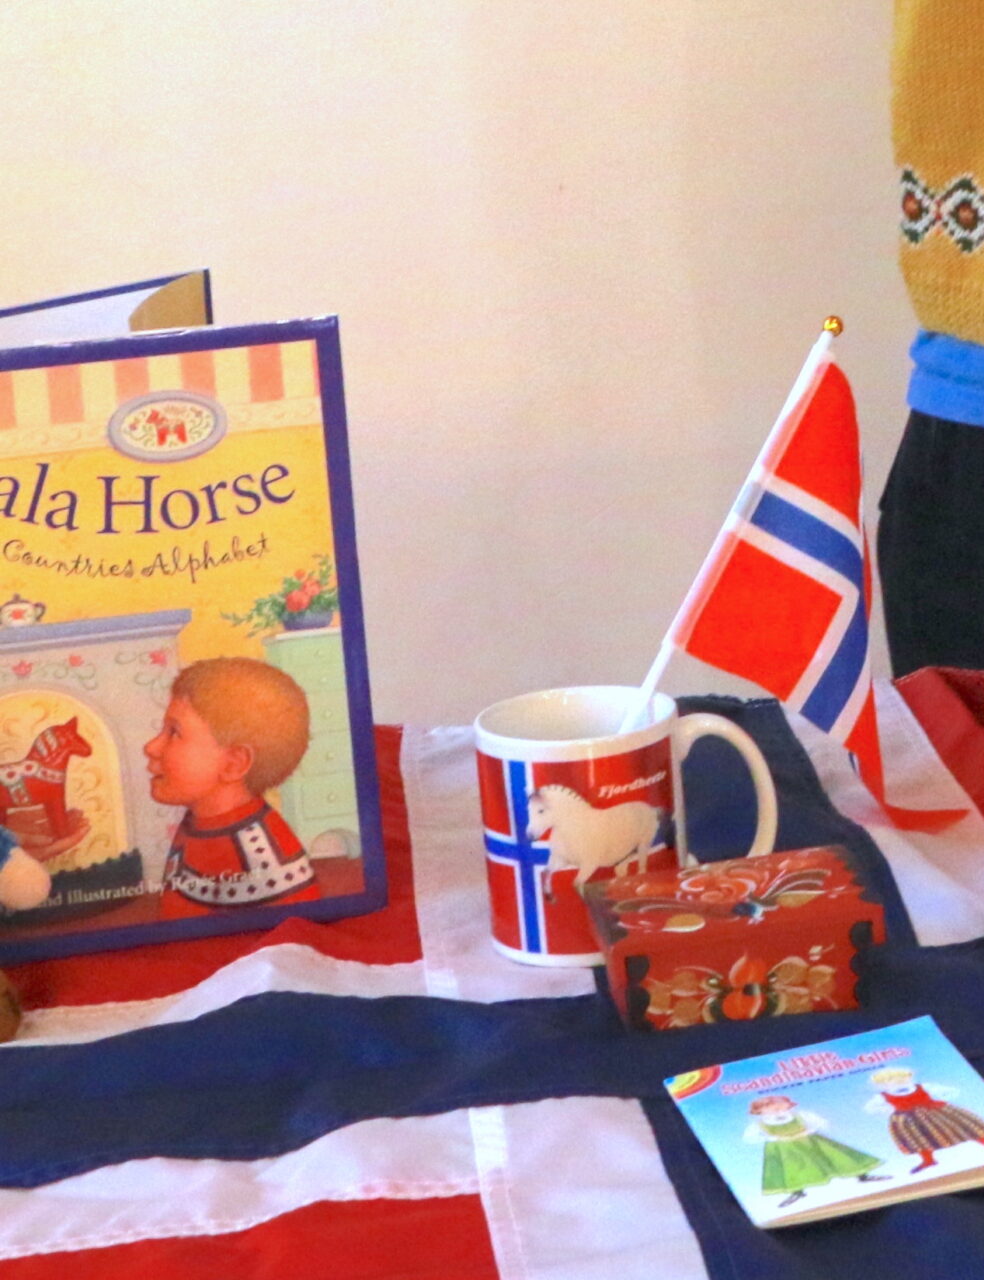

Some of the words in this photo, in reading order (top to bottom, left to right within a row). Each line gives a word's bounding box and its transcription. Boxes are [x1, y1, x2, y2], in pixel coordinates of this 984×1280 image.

[96, 463, 296, 534] Horse
[2, 539, 135, 578] Countries
[141, 531, 270, 584] Alphabet
